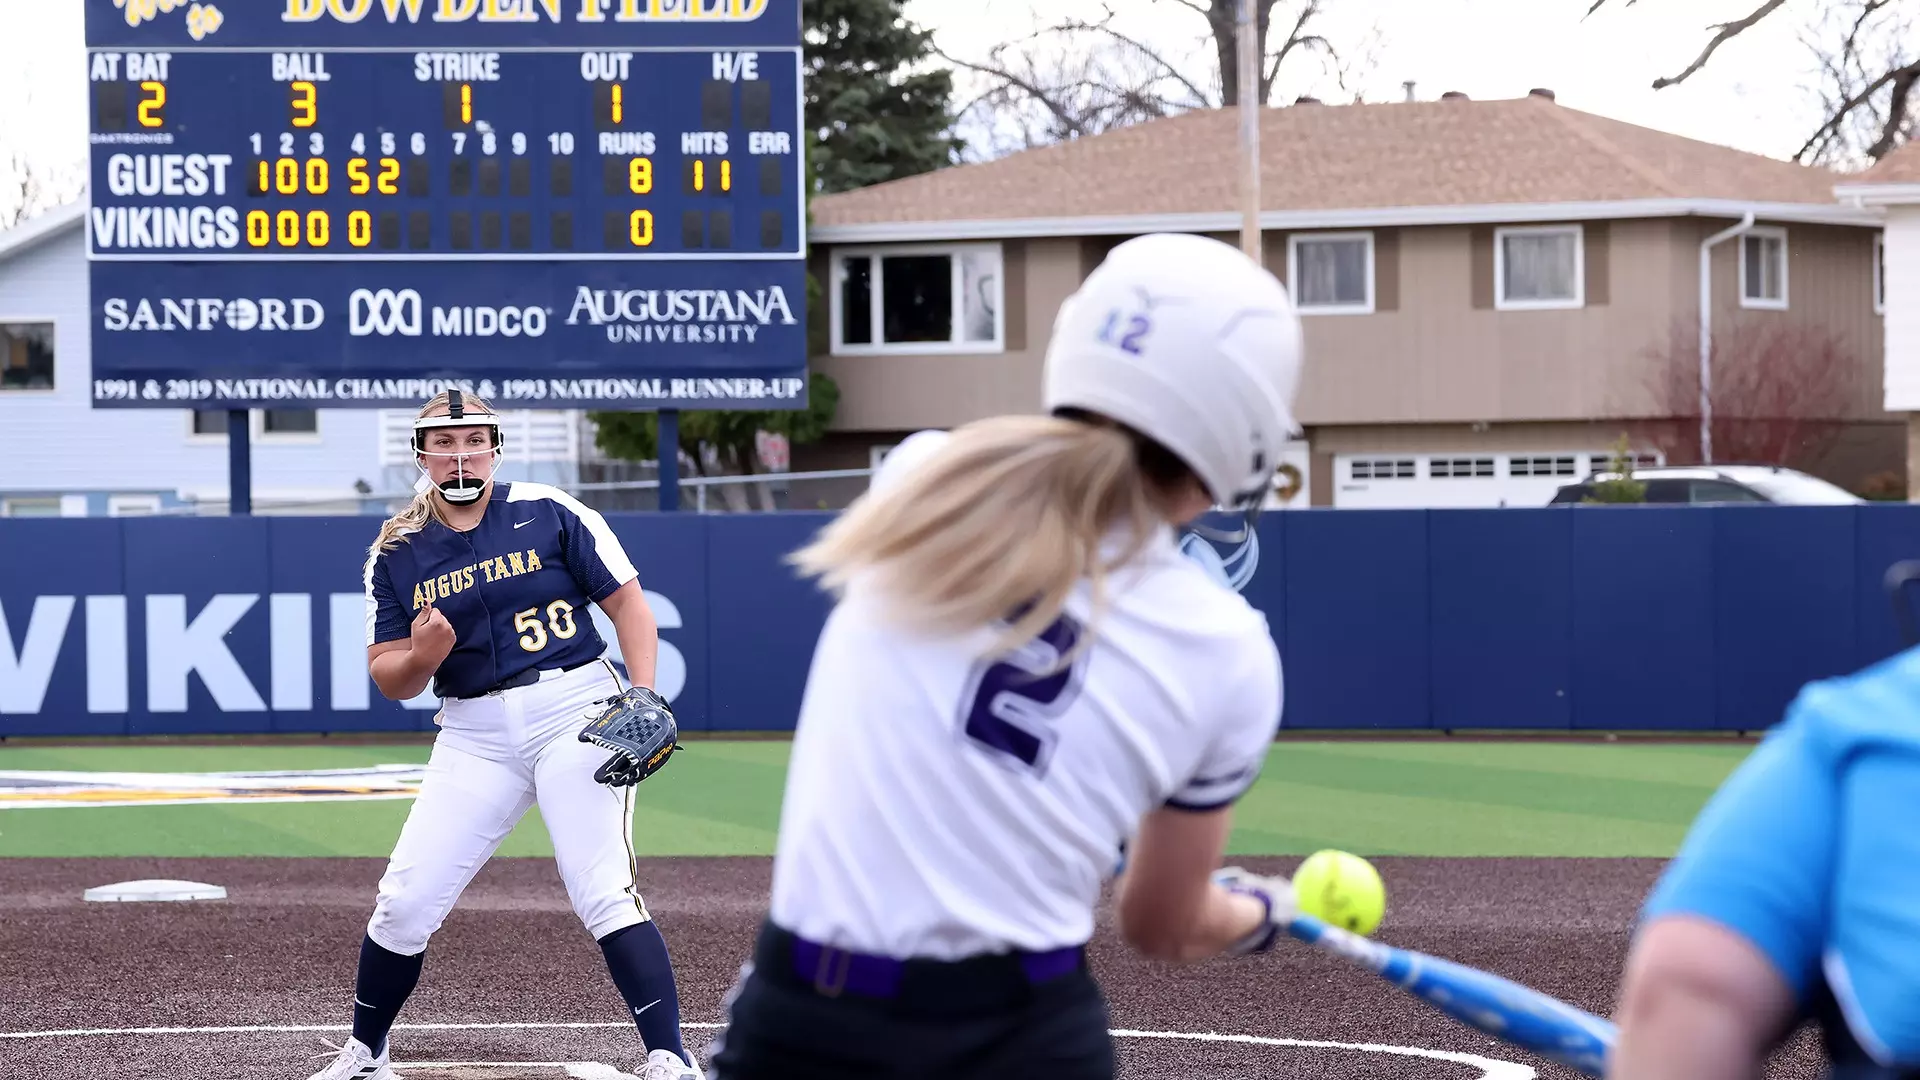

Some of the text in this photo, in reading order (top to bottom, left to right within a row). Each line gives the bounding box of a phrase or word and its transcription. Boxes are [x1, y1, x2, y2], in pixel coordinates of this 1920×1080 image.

[91, 53, 172, 81] AT BAT
[272, 53, 331, 81] BALL
[414, 52, 500, 81] STRIKE
[581, 52, 633, 81] OUT
[712, 52, 759, 83] H/E
[137, 82, 166, 127] 2
[291, 82, 317, 127] 3
[461, 84, 472, 124] 1
[612, 84, 623, 124] 1
[250, 132, 791, 155] 1 2 3 4 5 6 7 8 9 10 RUNS HITS ERR
[108, 154, 232, 196] GUEST
[629, 157, 652, 194] 8
[693, 160, 730, 191] 11
[91, 206, 240, 248] VIKINGS
[630, 209, 653, 246] 0
[103, 298, 325, 331] SANFORD
[432, 306, 547, 337] MIDCO
[564, 286, 798, 325] AUGUSTANA
[606, 325, 759, 343] UNIVERSITY
[93, 378, 803, 400] 1991 & 2019 NATIONAL CHAMPIONS & 1993 NATIONAL RUNNER-UP
[413, 548, 542, 610] AUGUSTANA
[514, 599, 577, 652] 50
[955, 594, 1090, 781] 2
